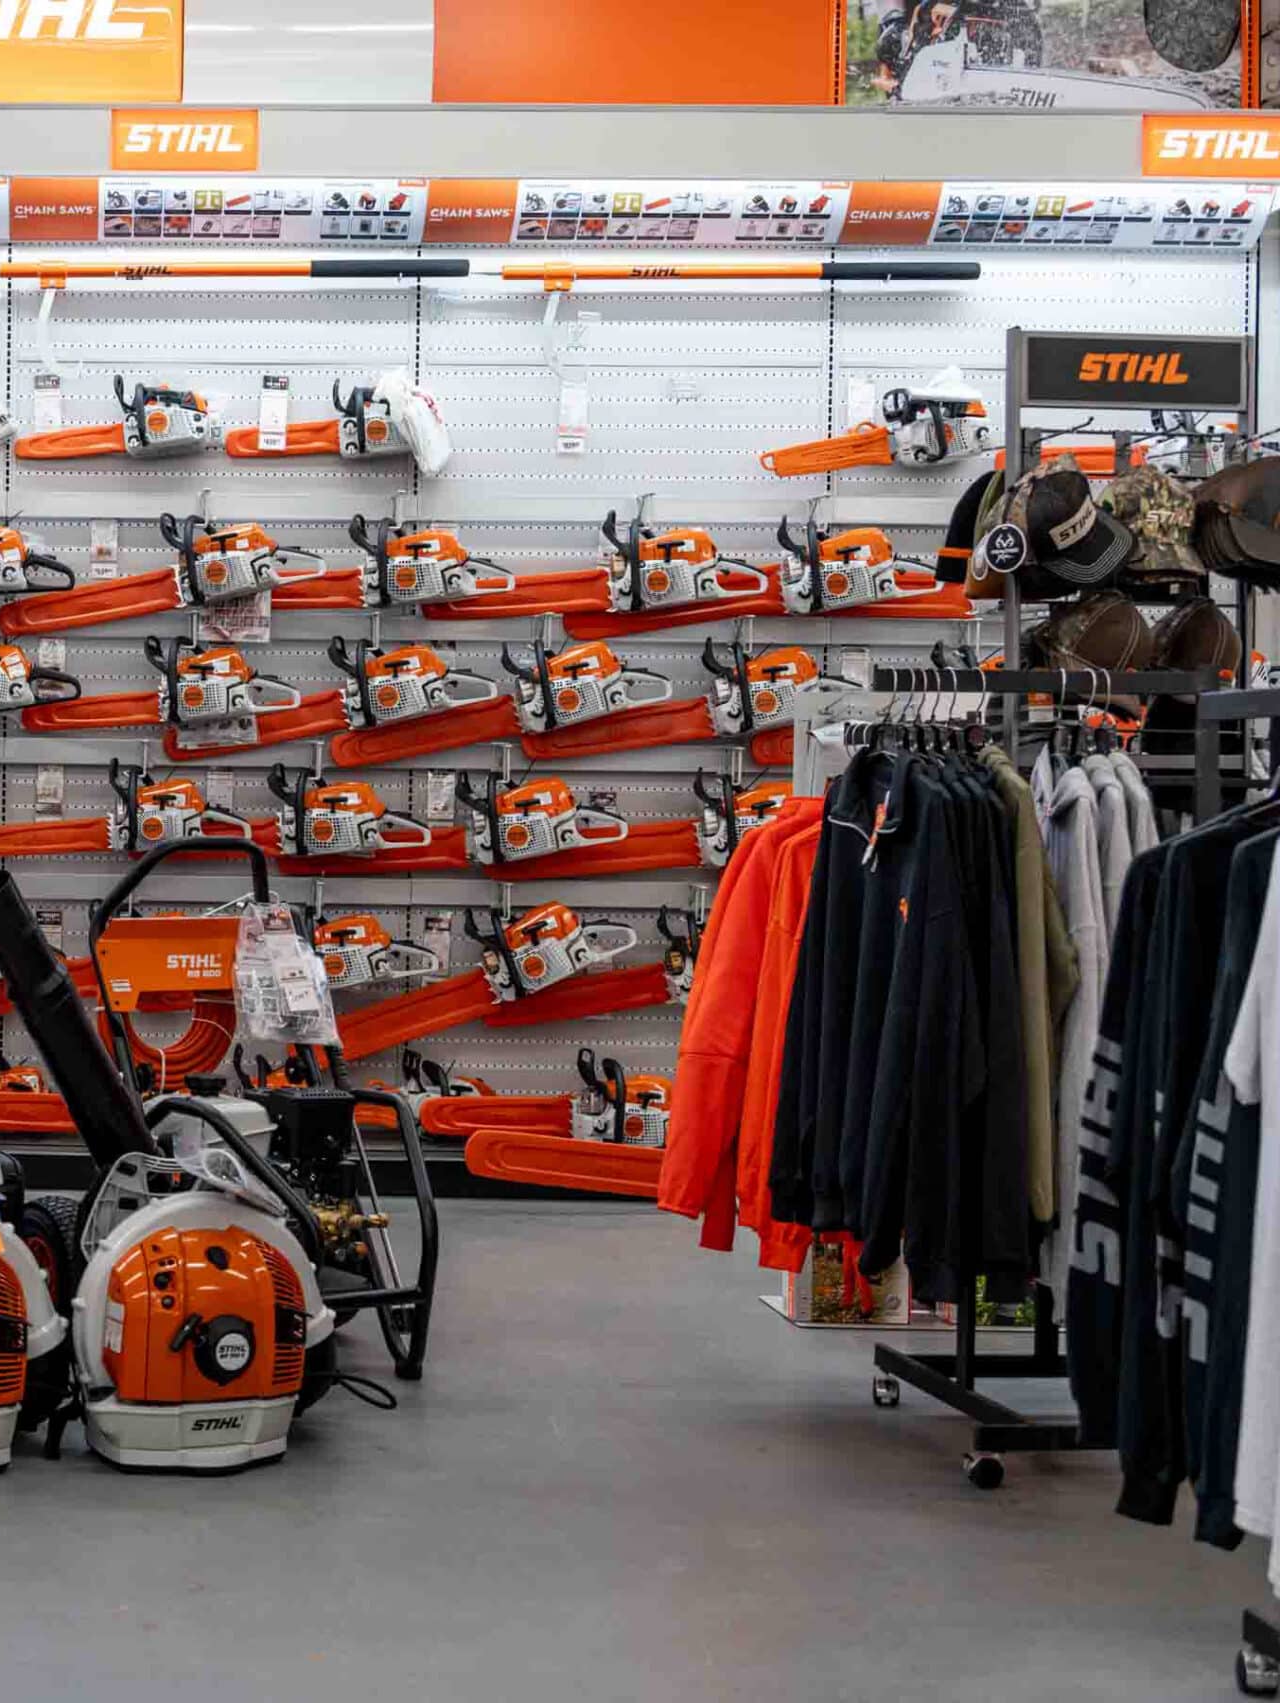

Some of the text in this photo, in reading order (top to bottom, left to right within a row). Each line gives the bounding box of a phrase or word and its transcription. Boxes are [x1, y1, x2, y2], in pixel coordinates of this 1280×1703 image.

[124, 124, 243, 152] STIHL
[1159, 130, 1280, 159] STIHL
[14, 205, 94, 215] CHAIN SAWS
[430, 208, 510, 218] CHAIN SAWS
[850, 210, 931, 220] CHAIN SAWS
[122, 265, 173, 276] STIHL
[628, 267, 681, 278] STIHL
[1079, 351, 1189, 385] STIHL
[1059, 506, 1094, 542] STIHL
[167, 953, 222, 969] STIHL
[218, 1344, 247, 1355] STIHL
[191, 1417, 242, 1432] STIHL
